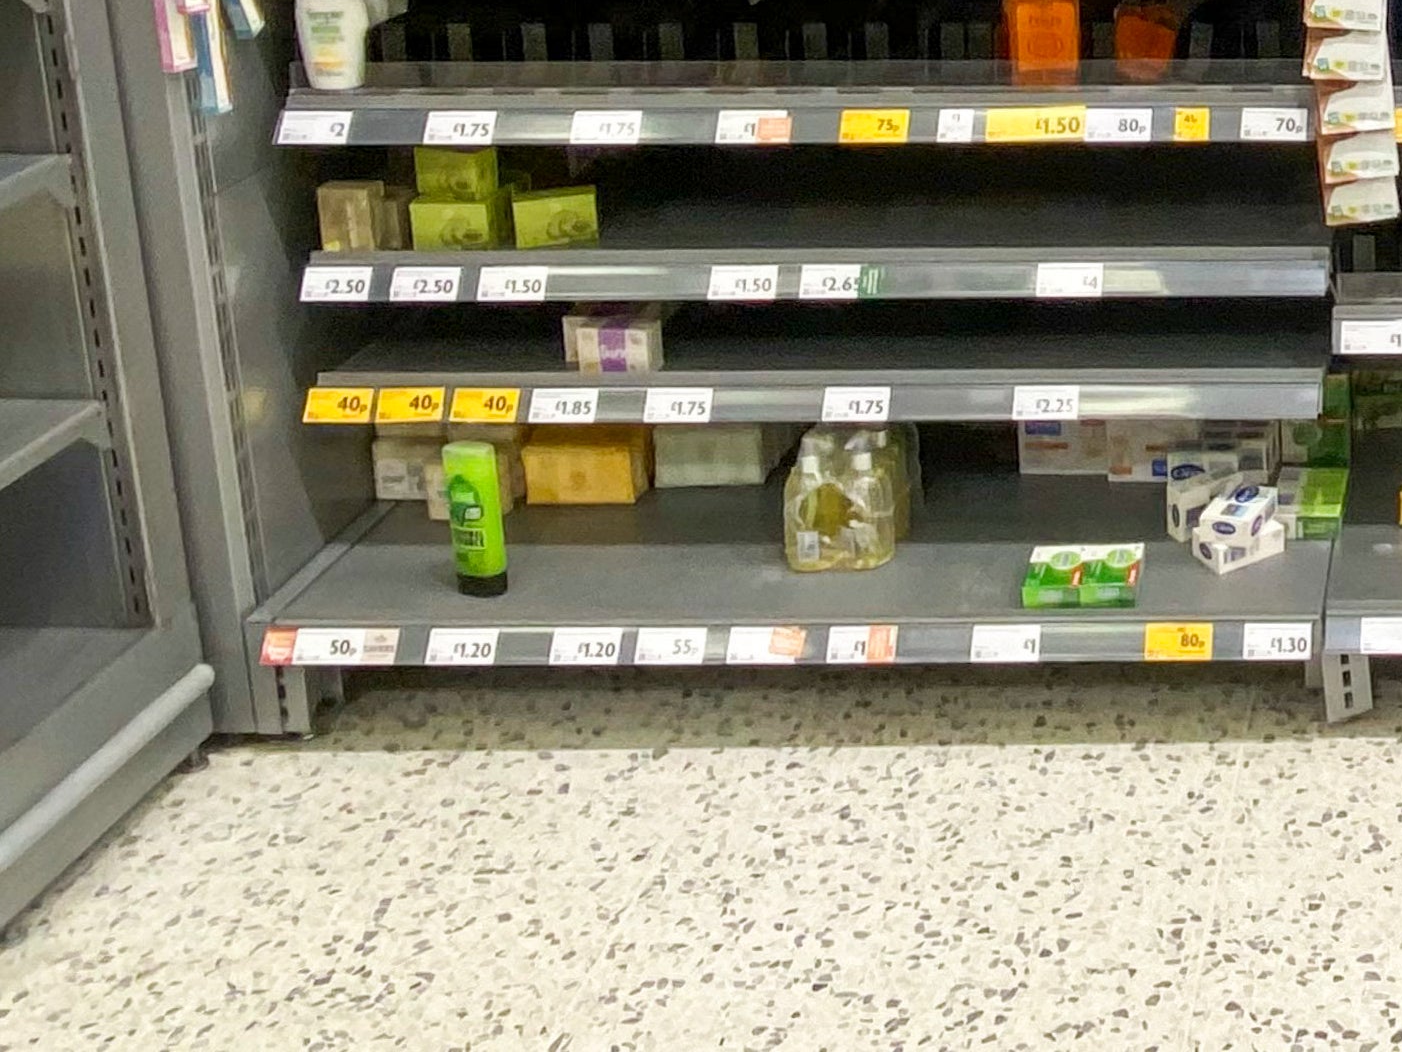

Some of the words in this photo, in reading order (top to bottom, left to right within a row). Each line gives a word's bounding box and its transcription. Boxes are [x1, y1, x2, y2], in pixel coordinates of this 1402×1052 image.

[330, 122, 344, 137] £2
[454, 122, 489, 137] £1.75
[599, 122, 634, 137] £1.75
[878, 119, 899, 132] 75p
[1036, 116, 1080, 133] £1.50
[1118, 119, 1145, 134] 80p
[1276, 118, 1302, 134] 70p
[326, 280, 365, 294] £2.50
[414, 280, 453, 294] £2.50
[505, 280, 541, 293] £1.50
[736, 278, 771, 292] £1.50
[1083, 276, 1097, 289] £4
[338, 396, 368, 414] 40p
[410, 395, 439, 412] 40p
[484, 396, 513, 413] 40p
[555, 400, 591, 415] £1.85
[671, 400, 706, 416] £1.75
[849, 400, 883, 415] £1.75
[1036, 398, 1073, 413] £2.25
[330, 639, 357, 657] 50p
[673, 639, 698, 655] 55p
[1023, 639, 1035, 654] £1
[1180, 633, 1204, 648] 80p
[1270, 637, 1306, 654] £1.30
[454, 642, 492, 658] £1.20
[578, 642, 615, 658] £1.20
